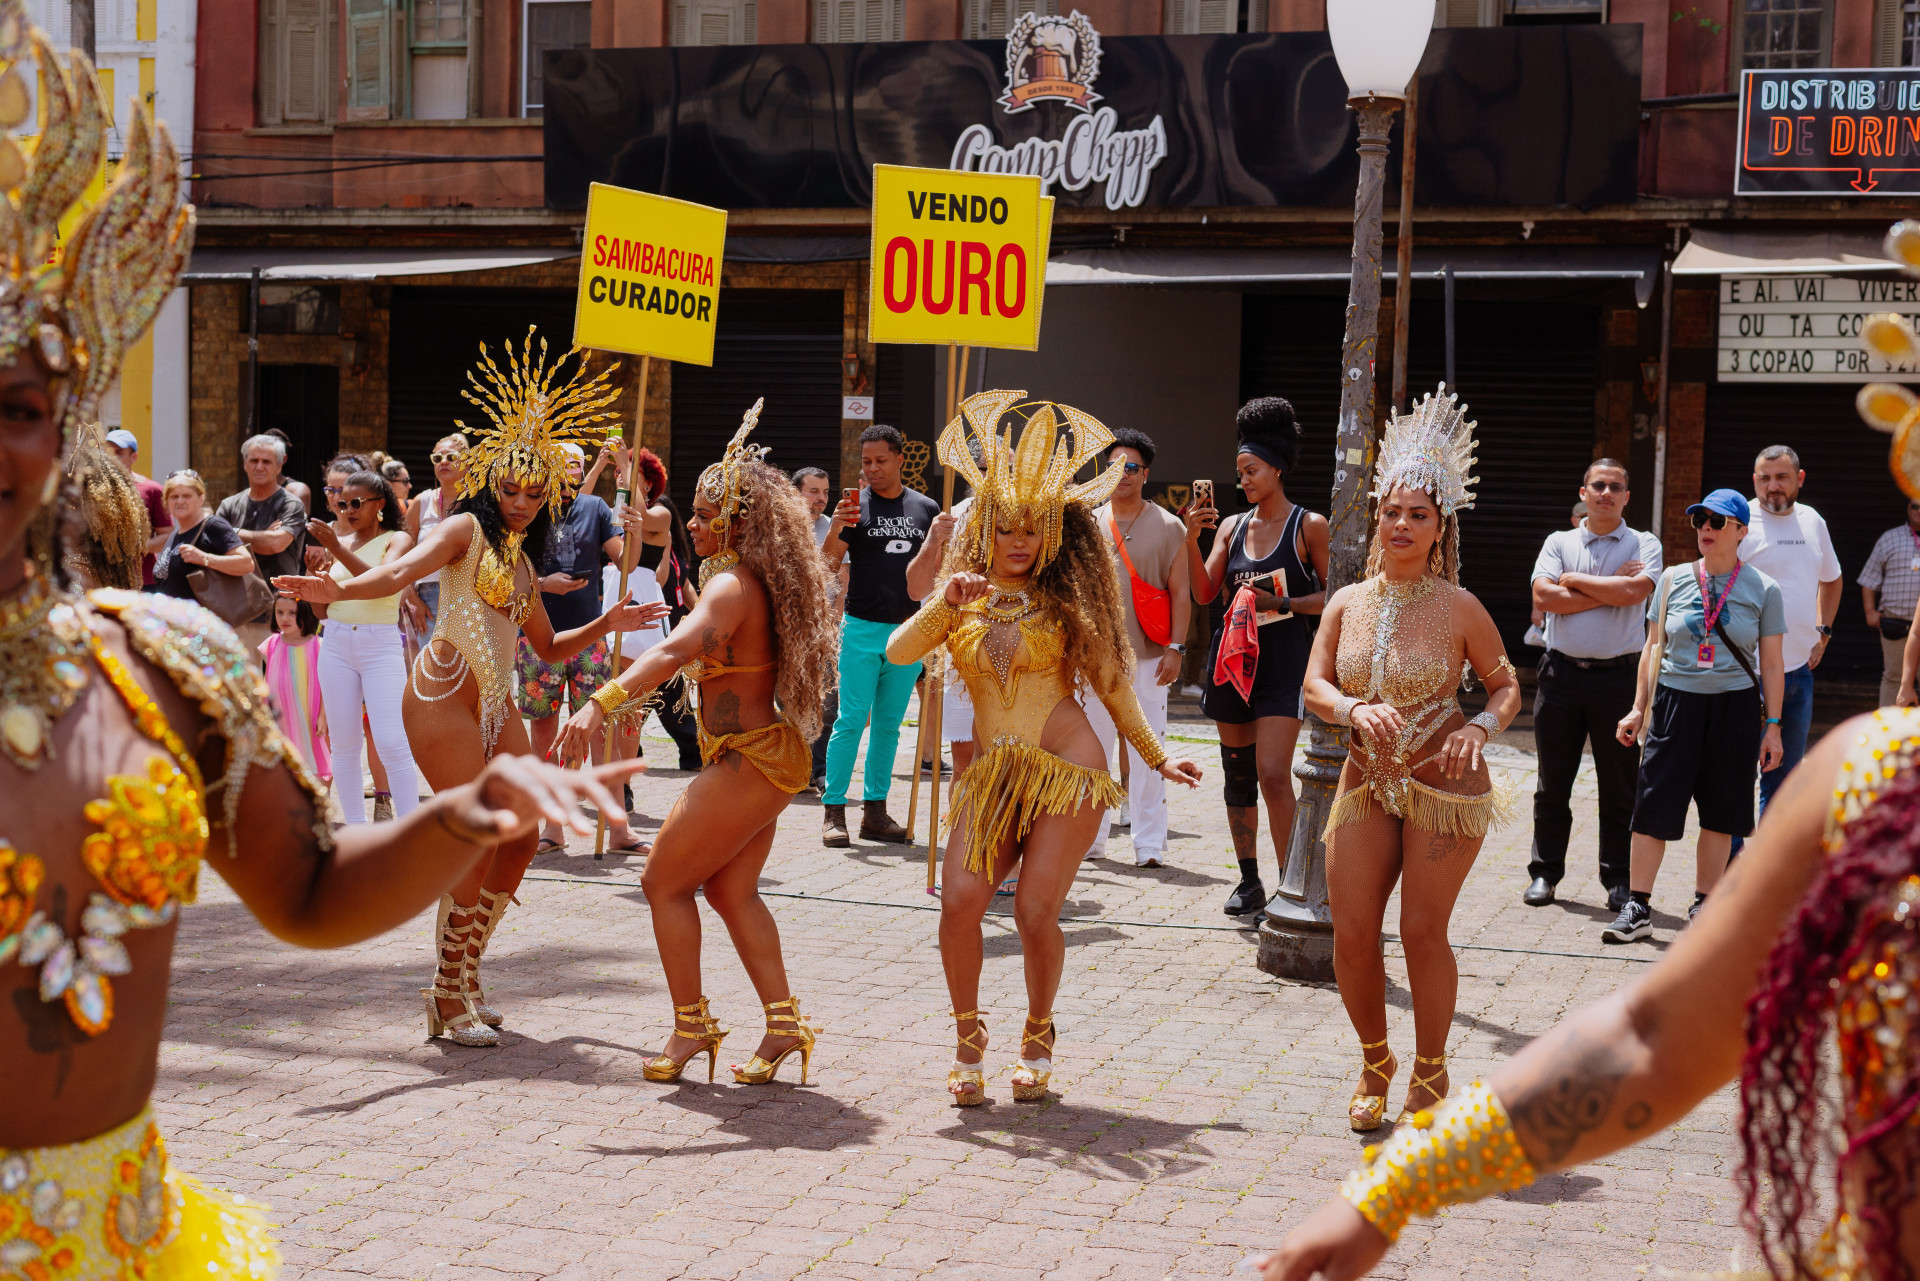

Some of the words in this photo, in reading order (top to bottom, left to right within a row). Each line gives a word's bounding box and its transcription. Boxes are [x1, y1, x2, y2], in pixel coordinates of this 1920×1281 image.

[1028, 85, 1053, 95] DESDE
[1768, 116, 1816, 156] DE
[907, 190, 1009, 226] VENDO
[593, 234, 714, 288] SAMBACURA
[883, 235, 1027, 319] OURO
[1731, 281, 1741, 303] E
[1794, 279, 1825, 301] VAI
[1858, 282, 1918, 301] VIVER
[588, 275, 712, 323] CURADOR
[1739, 314, 1765, 337] OU
[1790, 314, 1814, 337] TA
[1731, 350, 1740, 372] 3
[1750, 350, 1814, 373] COPAO
[868, 527, 925, 539] GENERATION
